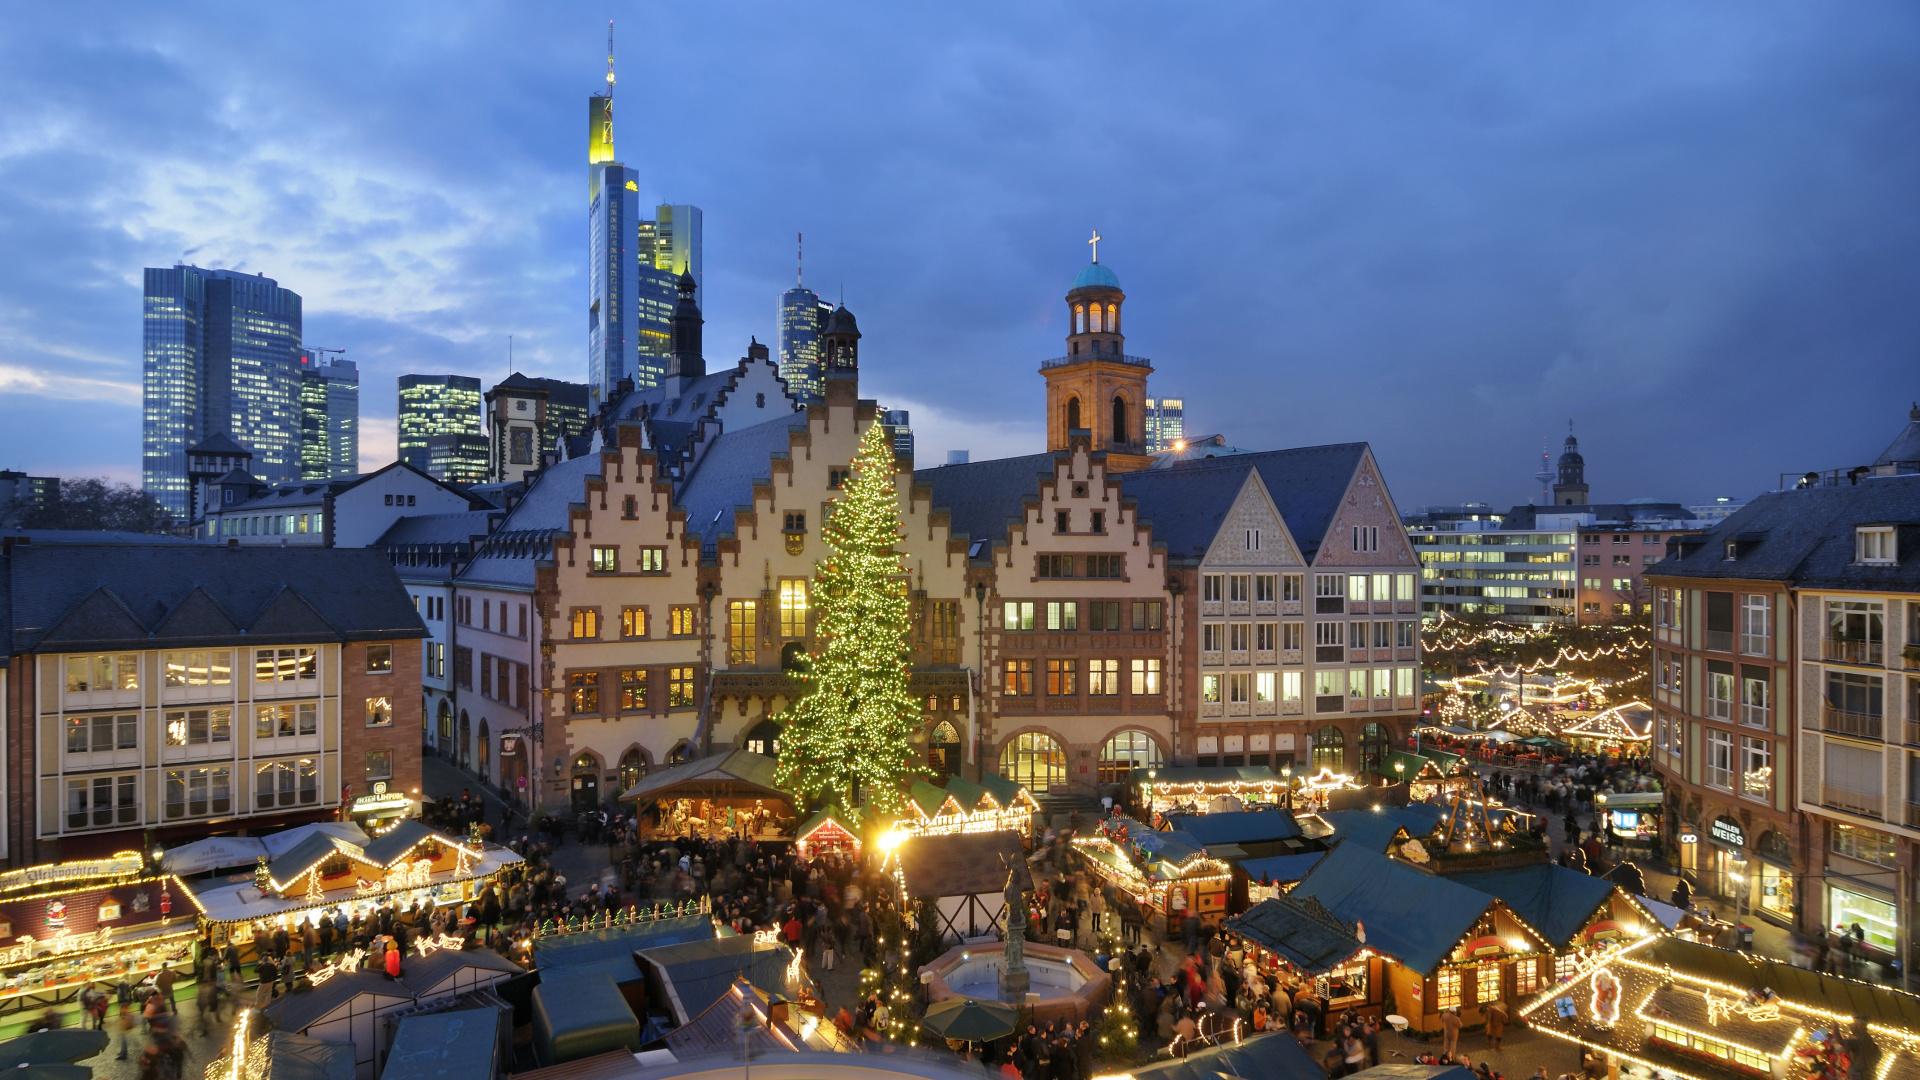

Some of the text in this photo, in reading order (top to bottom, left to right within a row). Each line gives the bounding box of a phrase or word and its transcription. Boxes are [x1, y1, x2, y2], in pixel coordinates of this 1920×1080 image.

[1623, 814, 1635, 826] U
[1714, 819, 1740, 835] BRILLEN
[1711, 826, 1744, 846] WEISS
[0, 865, 99, 888] rohe Weihnachten
